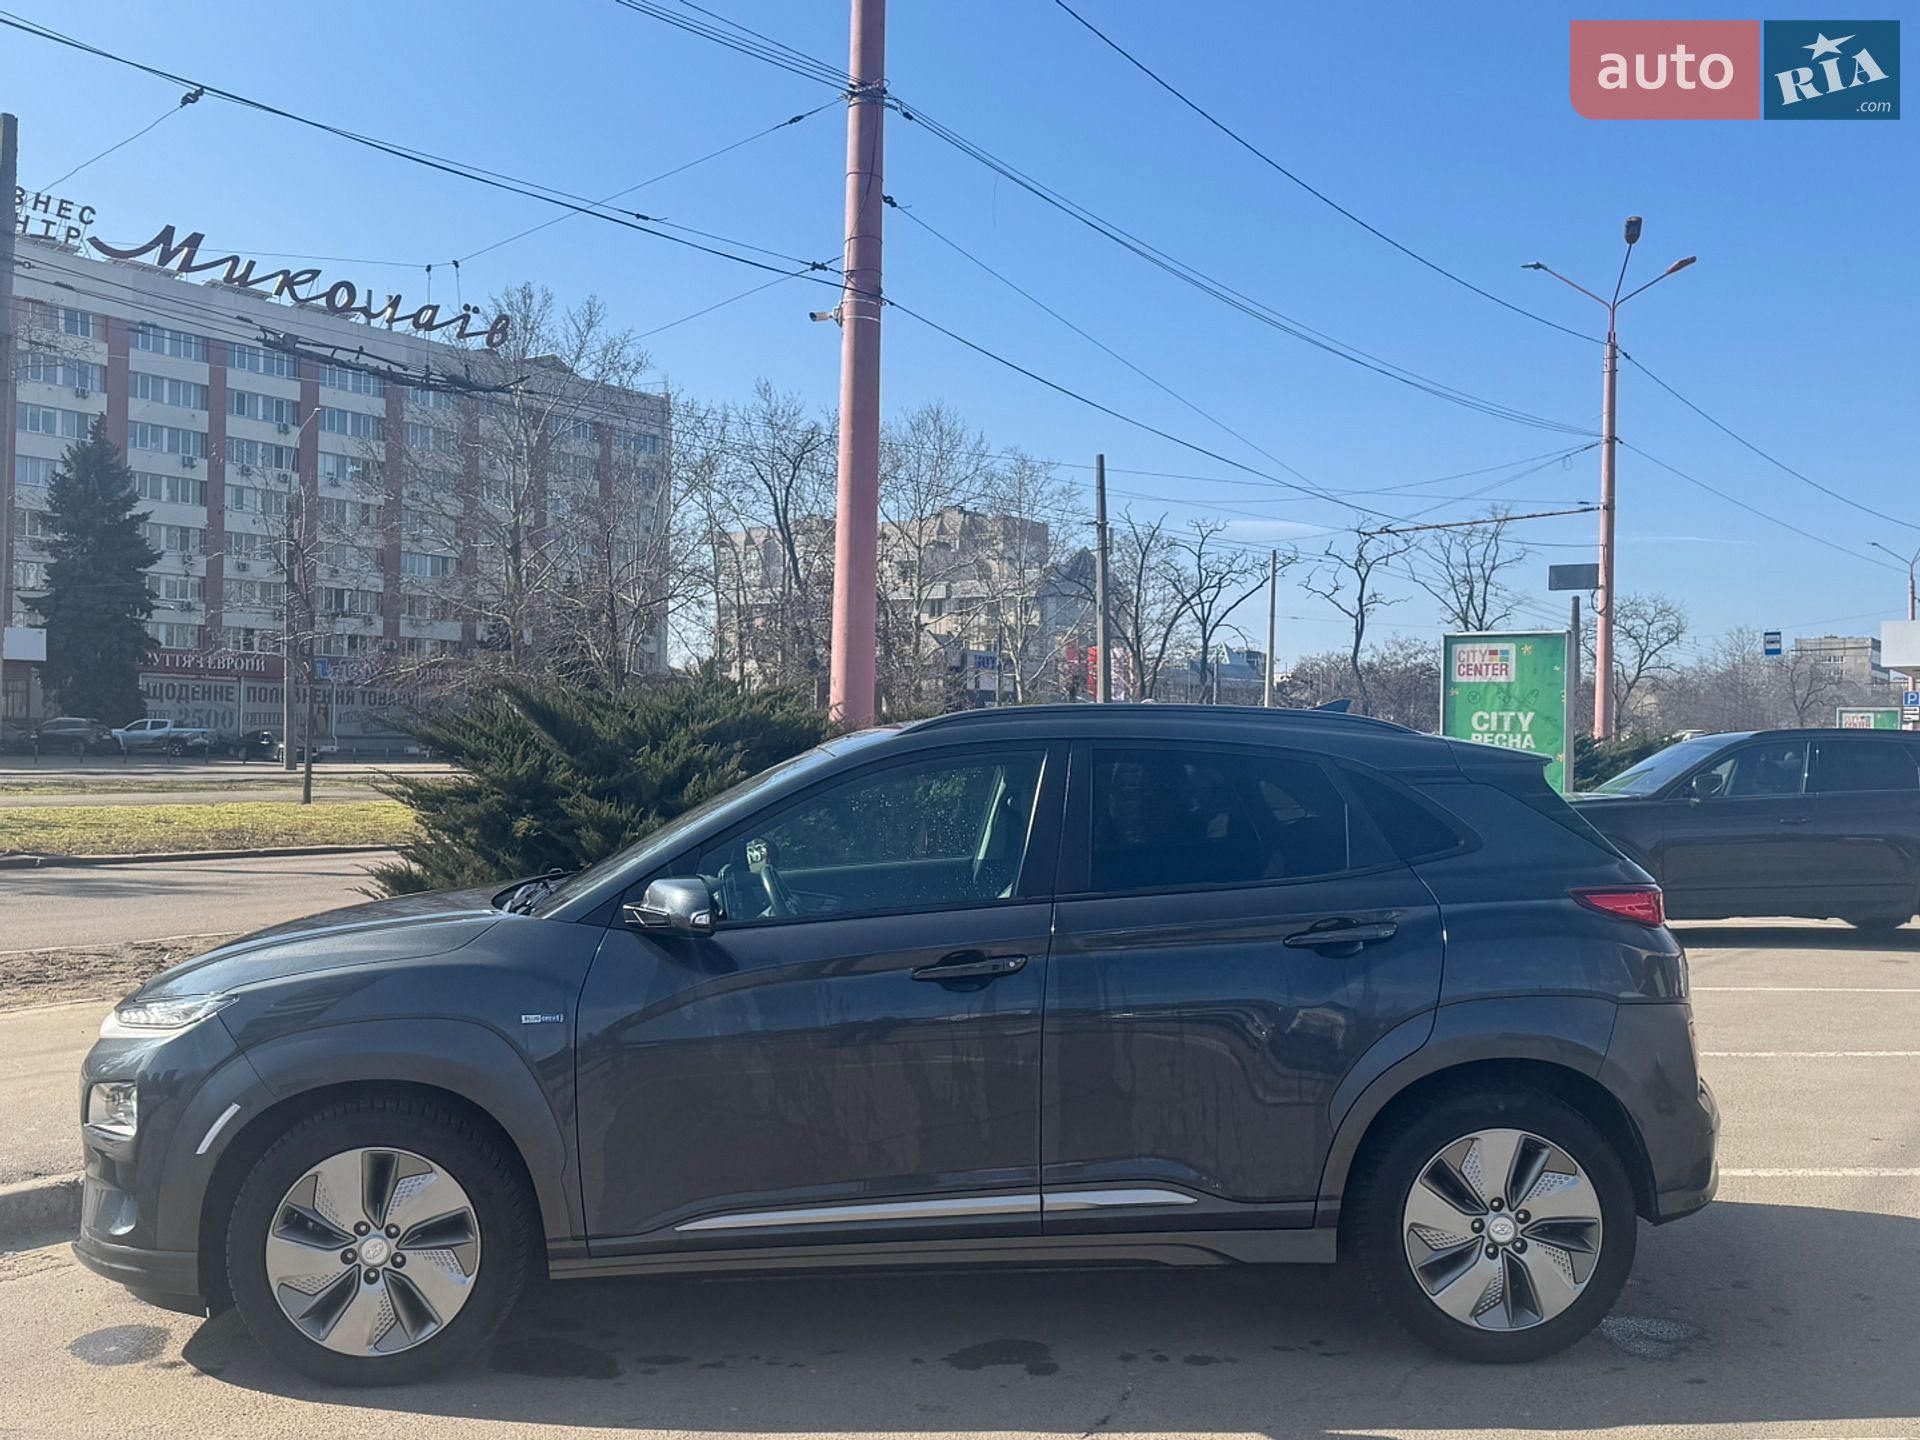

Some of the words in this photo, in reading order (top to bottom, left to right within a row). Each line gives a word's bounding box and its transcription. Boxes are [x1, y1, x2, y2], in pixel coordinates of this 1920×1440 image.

[15, 186, 96, 225] ЗНЕС
[15, 212, 81, 244] НТР
[87, 224, 510, 348] Миколаїв
[1458, 649, 1489, 663] CITY
[1457, 663, 1509, 677] CENTER
[1471, 711, 1536, 732] CITY
